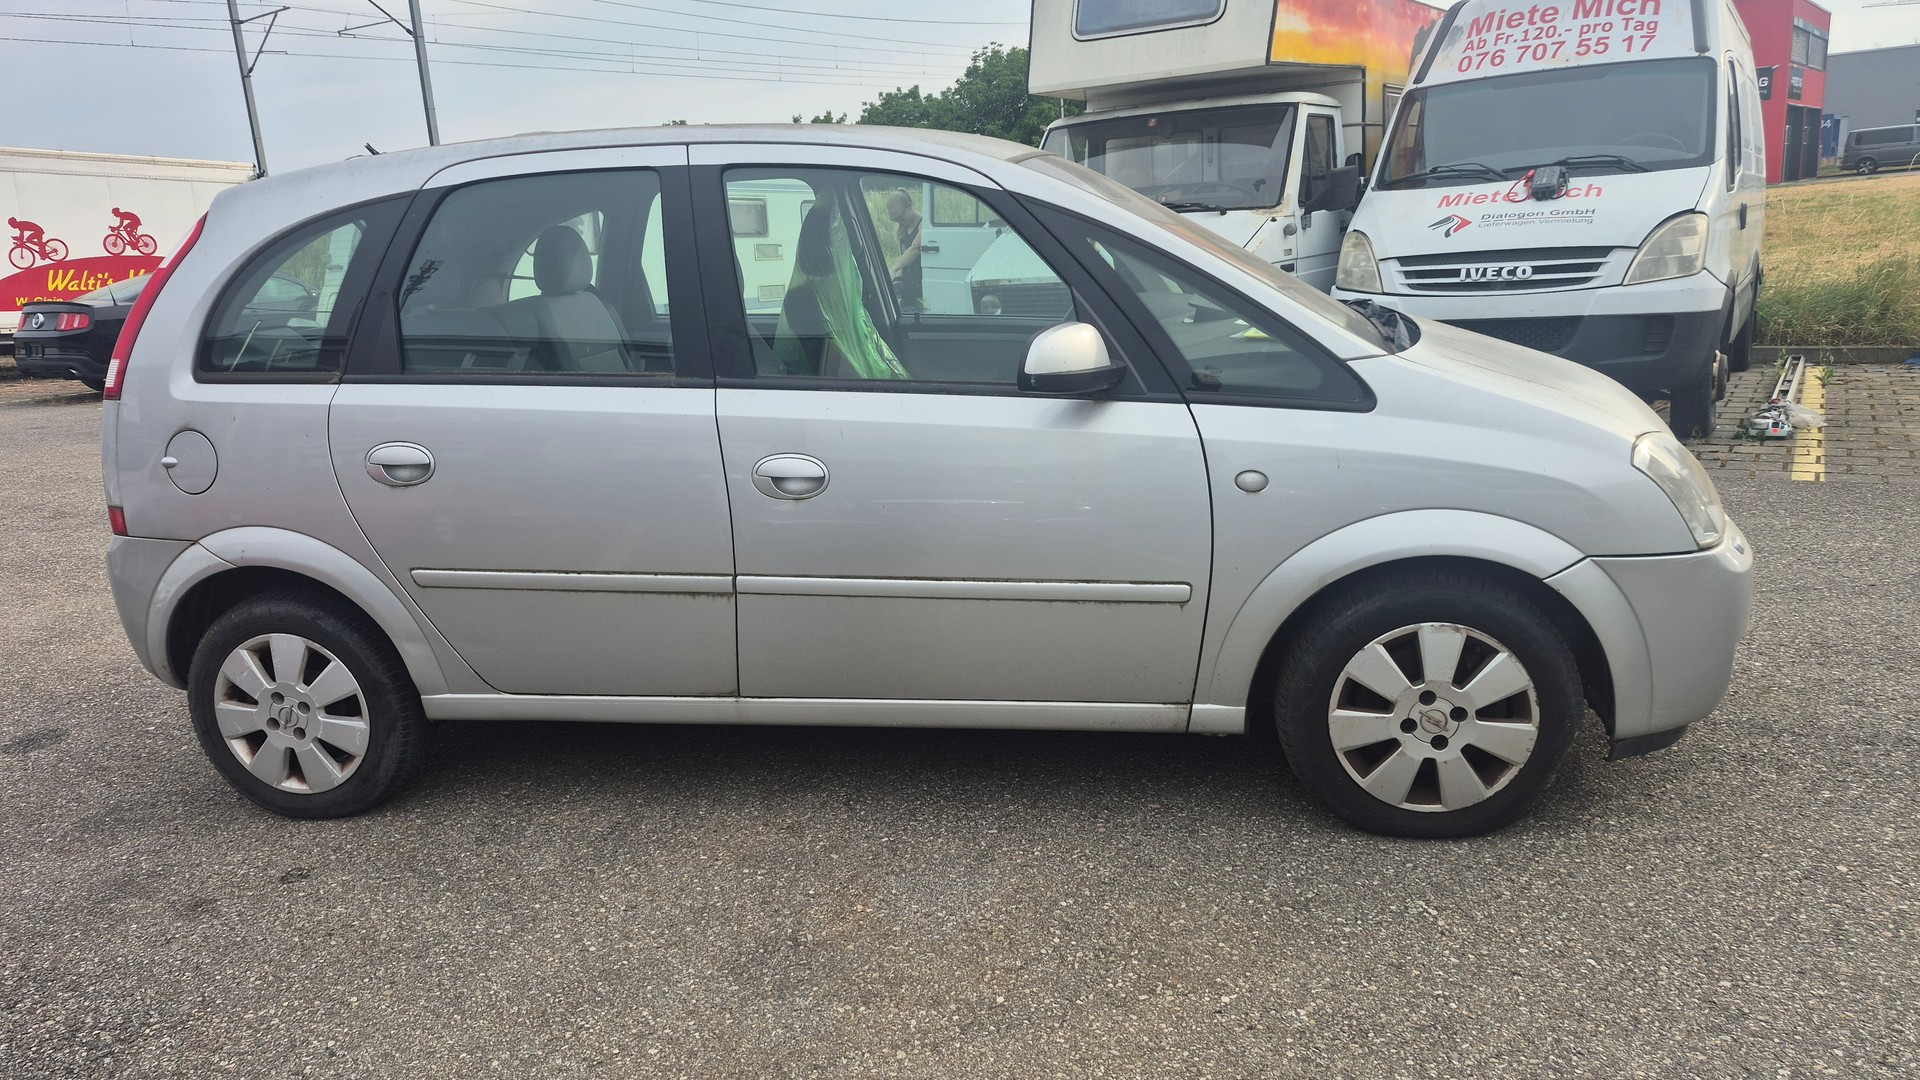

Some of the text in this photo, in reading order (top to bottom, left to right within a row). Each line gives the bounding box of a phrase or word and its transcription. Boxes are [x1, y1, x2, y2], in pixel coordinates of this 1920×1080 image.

[1466, 0, 1661, 39] Miete Mich
[1462, 17, 1658, 53] Ab Fr.120.- pro Tag
[1458, 35, 1656, 72] 076 707 55 17
[1437, 190, 1519, 208] Miete
[1478, 217, 1594, 228] Lieferwagen Vermietung
[1481, 208, 1596, 221] Dialogon GmbH
[1460, 265, 1533, 281] IVECO
